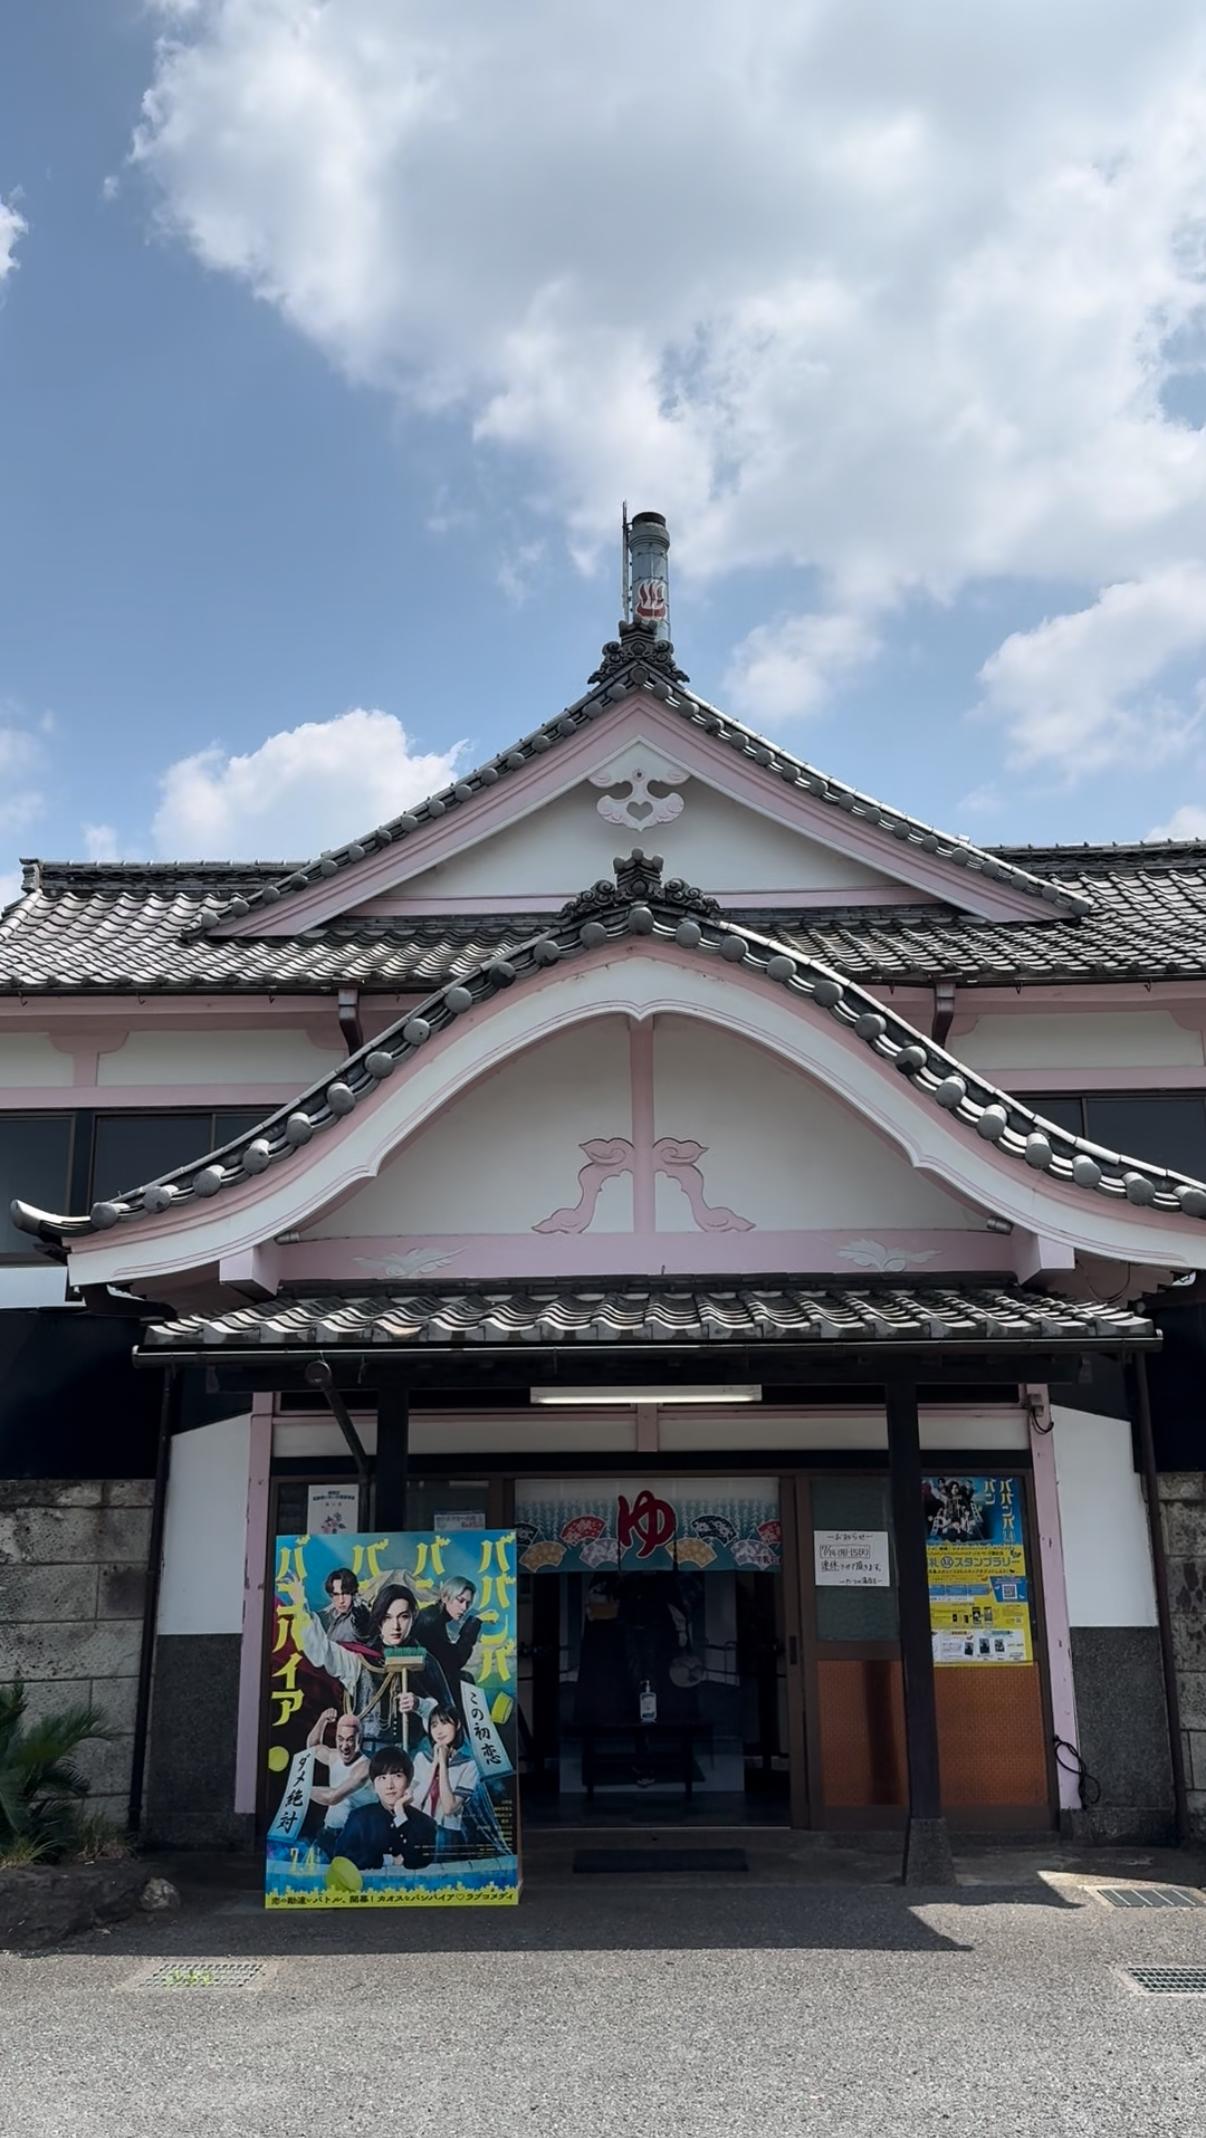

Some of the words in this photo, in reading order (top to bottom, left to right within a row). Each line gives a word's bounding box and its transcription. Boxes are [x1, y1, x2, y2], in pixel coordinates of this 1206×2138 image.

[617, 1490, 676, 1558] ゆ
[984, 1478, 996, 1505] バン
[999, 1477, 1015, 1530] ババンバ
[478, 1532, 516, 1682] ババンバ
[470, 1692, 501, 1765] この初恋
[276, 1752, 311, 1835] ダメ絶対
